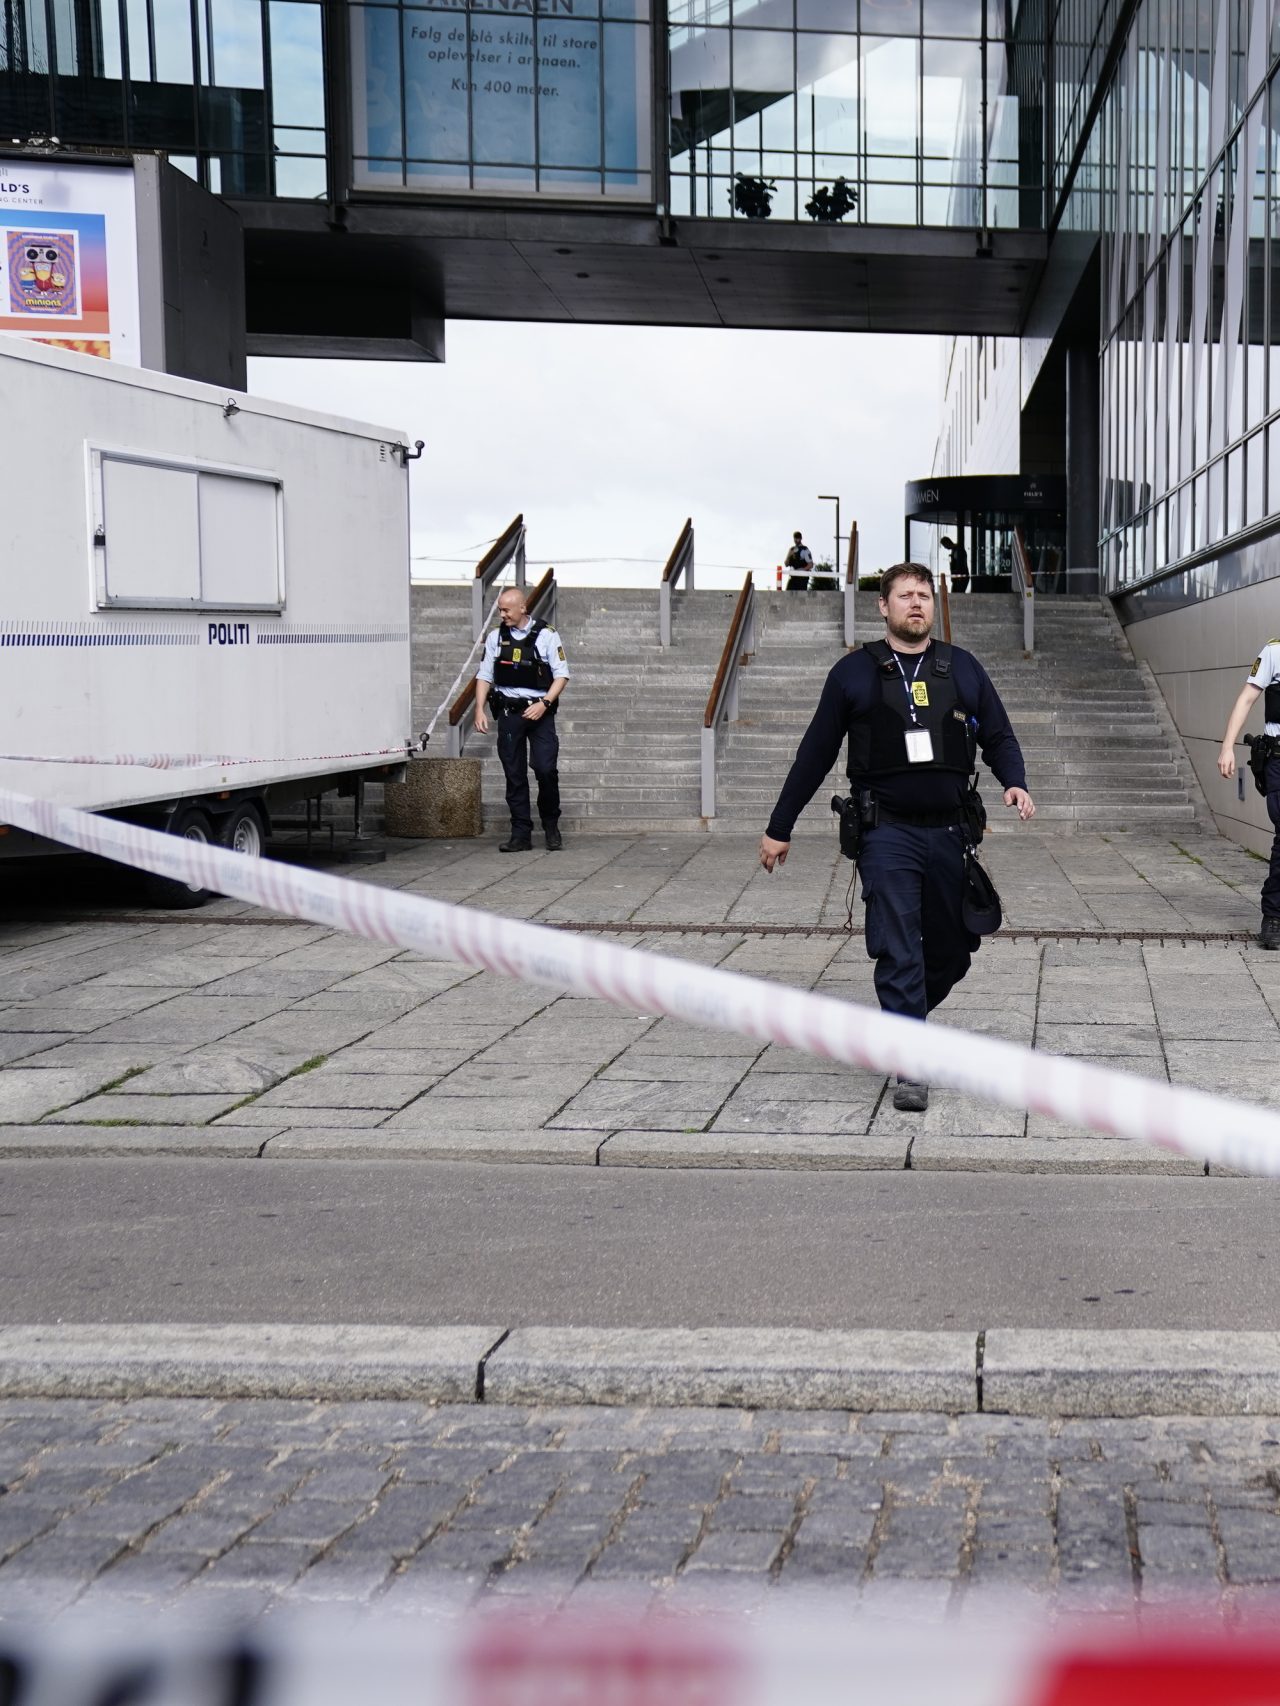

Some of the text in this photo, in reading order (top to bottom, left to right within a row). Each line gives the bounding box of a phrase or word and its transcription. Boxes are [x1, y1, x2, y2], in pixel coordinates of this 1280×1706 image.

[411, 26, 441, 42] Følg
[447, 28, 464, 42] de
[471, 30, 493, 43] blå
[542, 34, 556, 47] til
[562, 36, 598, 50] store
[428, 48, 501, 64] oplevelser
[518, 55, 581, 68] arenaen.
[451, 78, 478, 92] Kun
[483, 80, 512, 94] 400
[208, 623, 250, 645] POLITI
